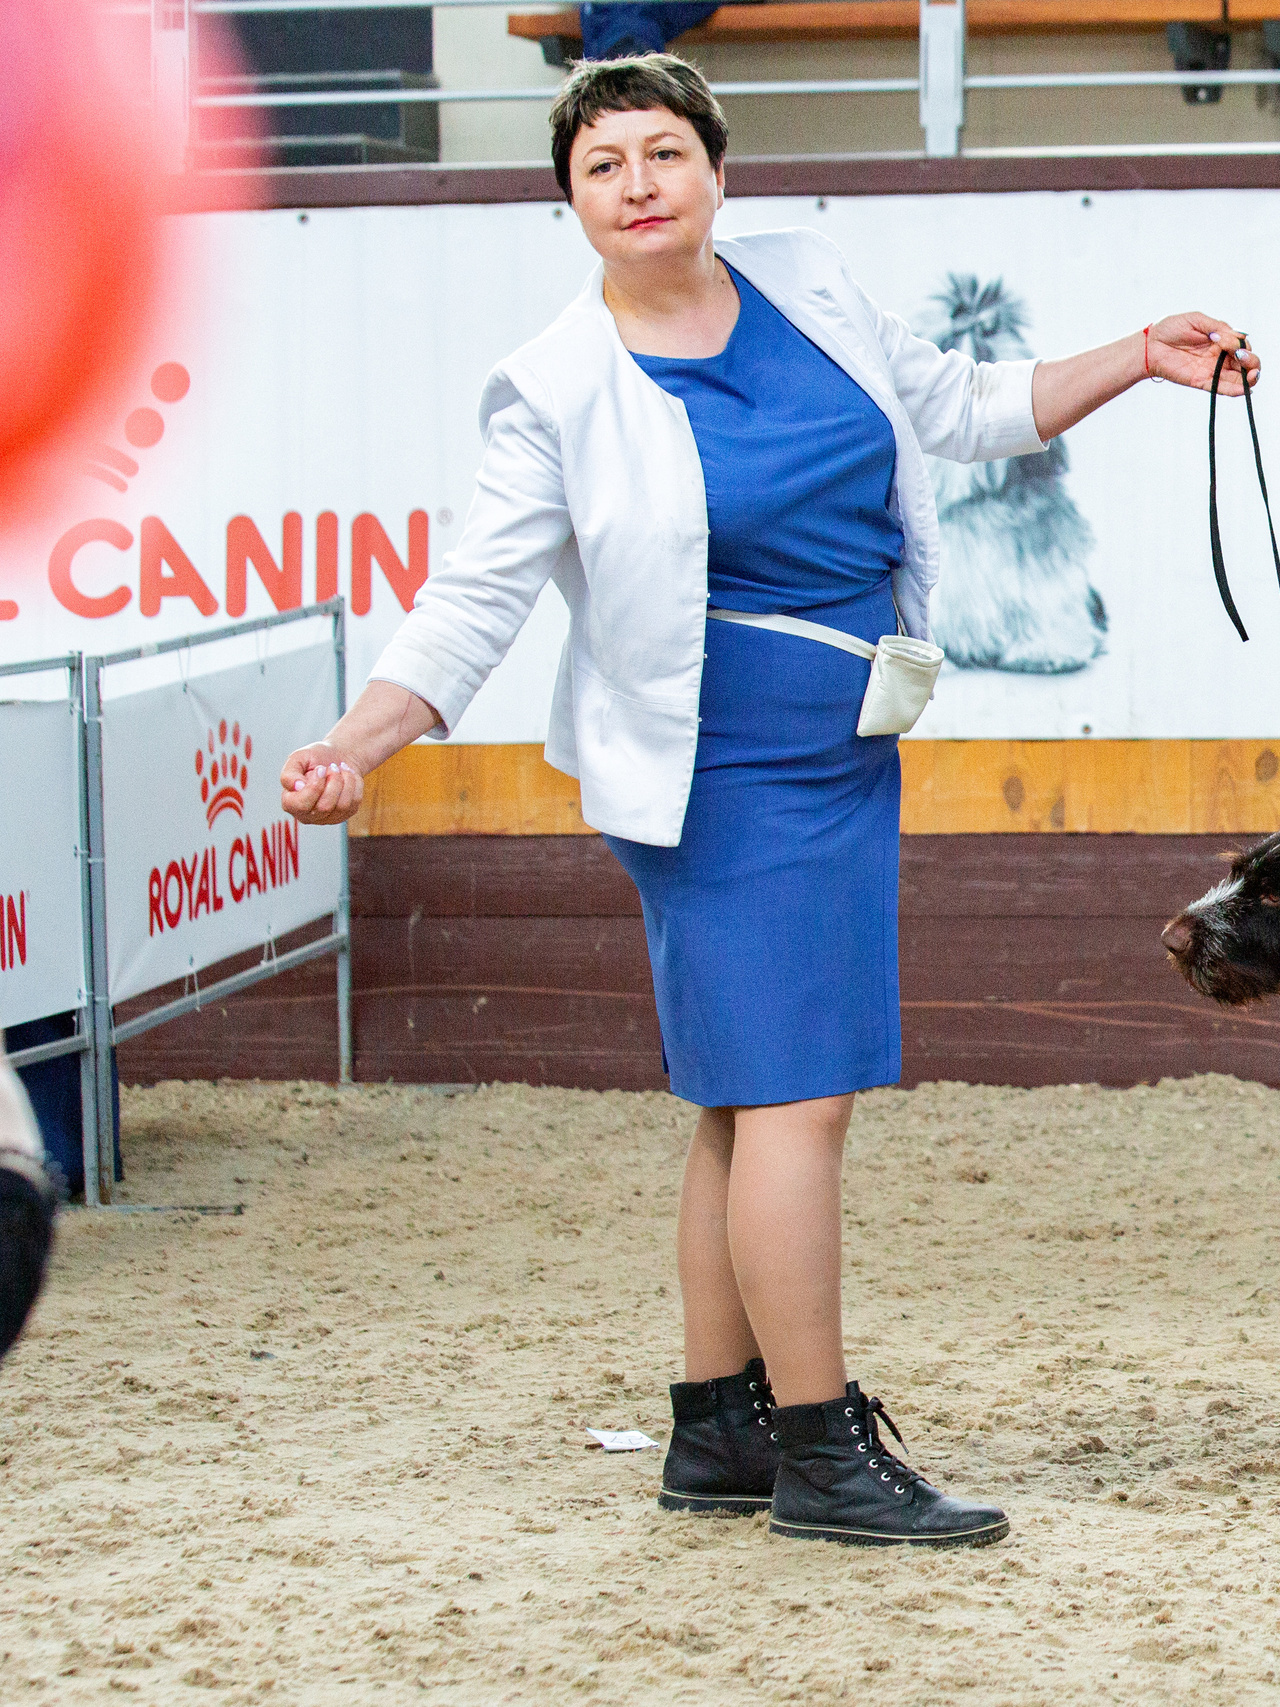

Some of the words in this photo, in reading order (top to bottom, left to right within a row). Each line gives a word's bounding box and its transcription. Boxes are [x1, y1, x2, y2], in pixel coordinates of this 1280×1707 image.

[48, 509, 430, 618] CANIN
[149, 845, 224, 937] ROYAL
[228, 817, 299, 903] CANIN
